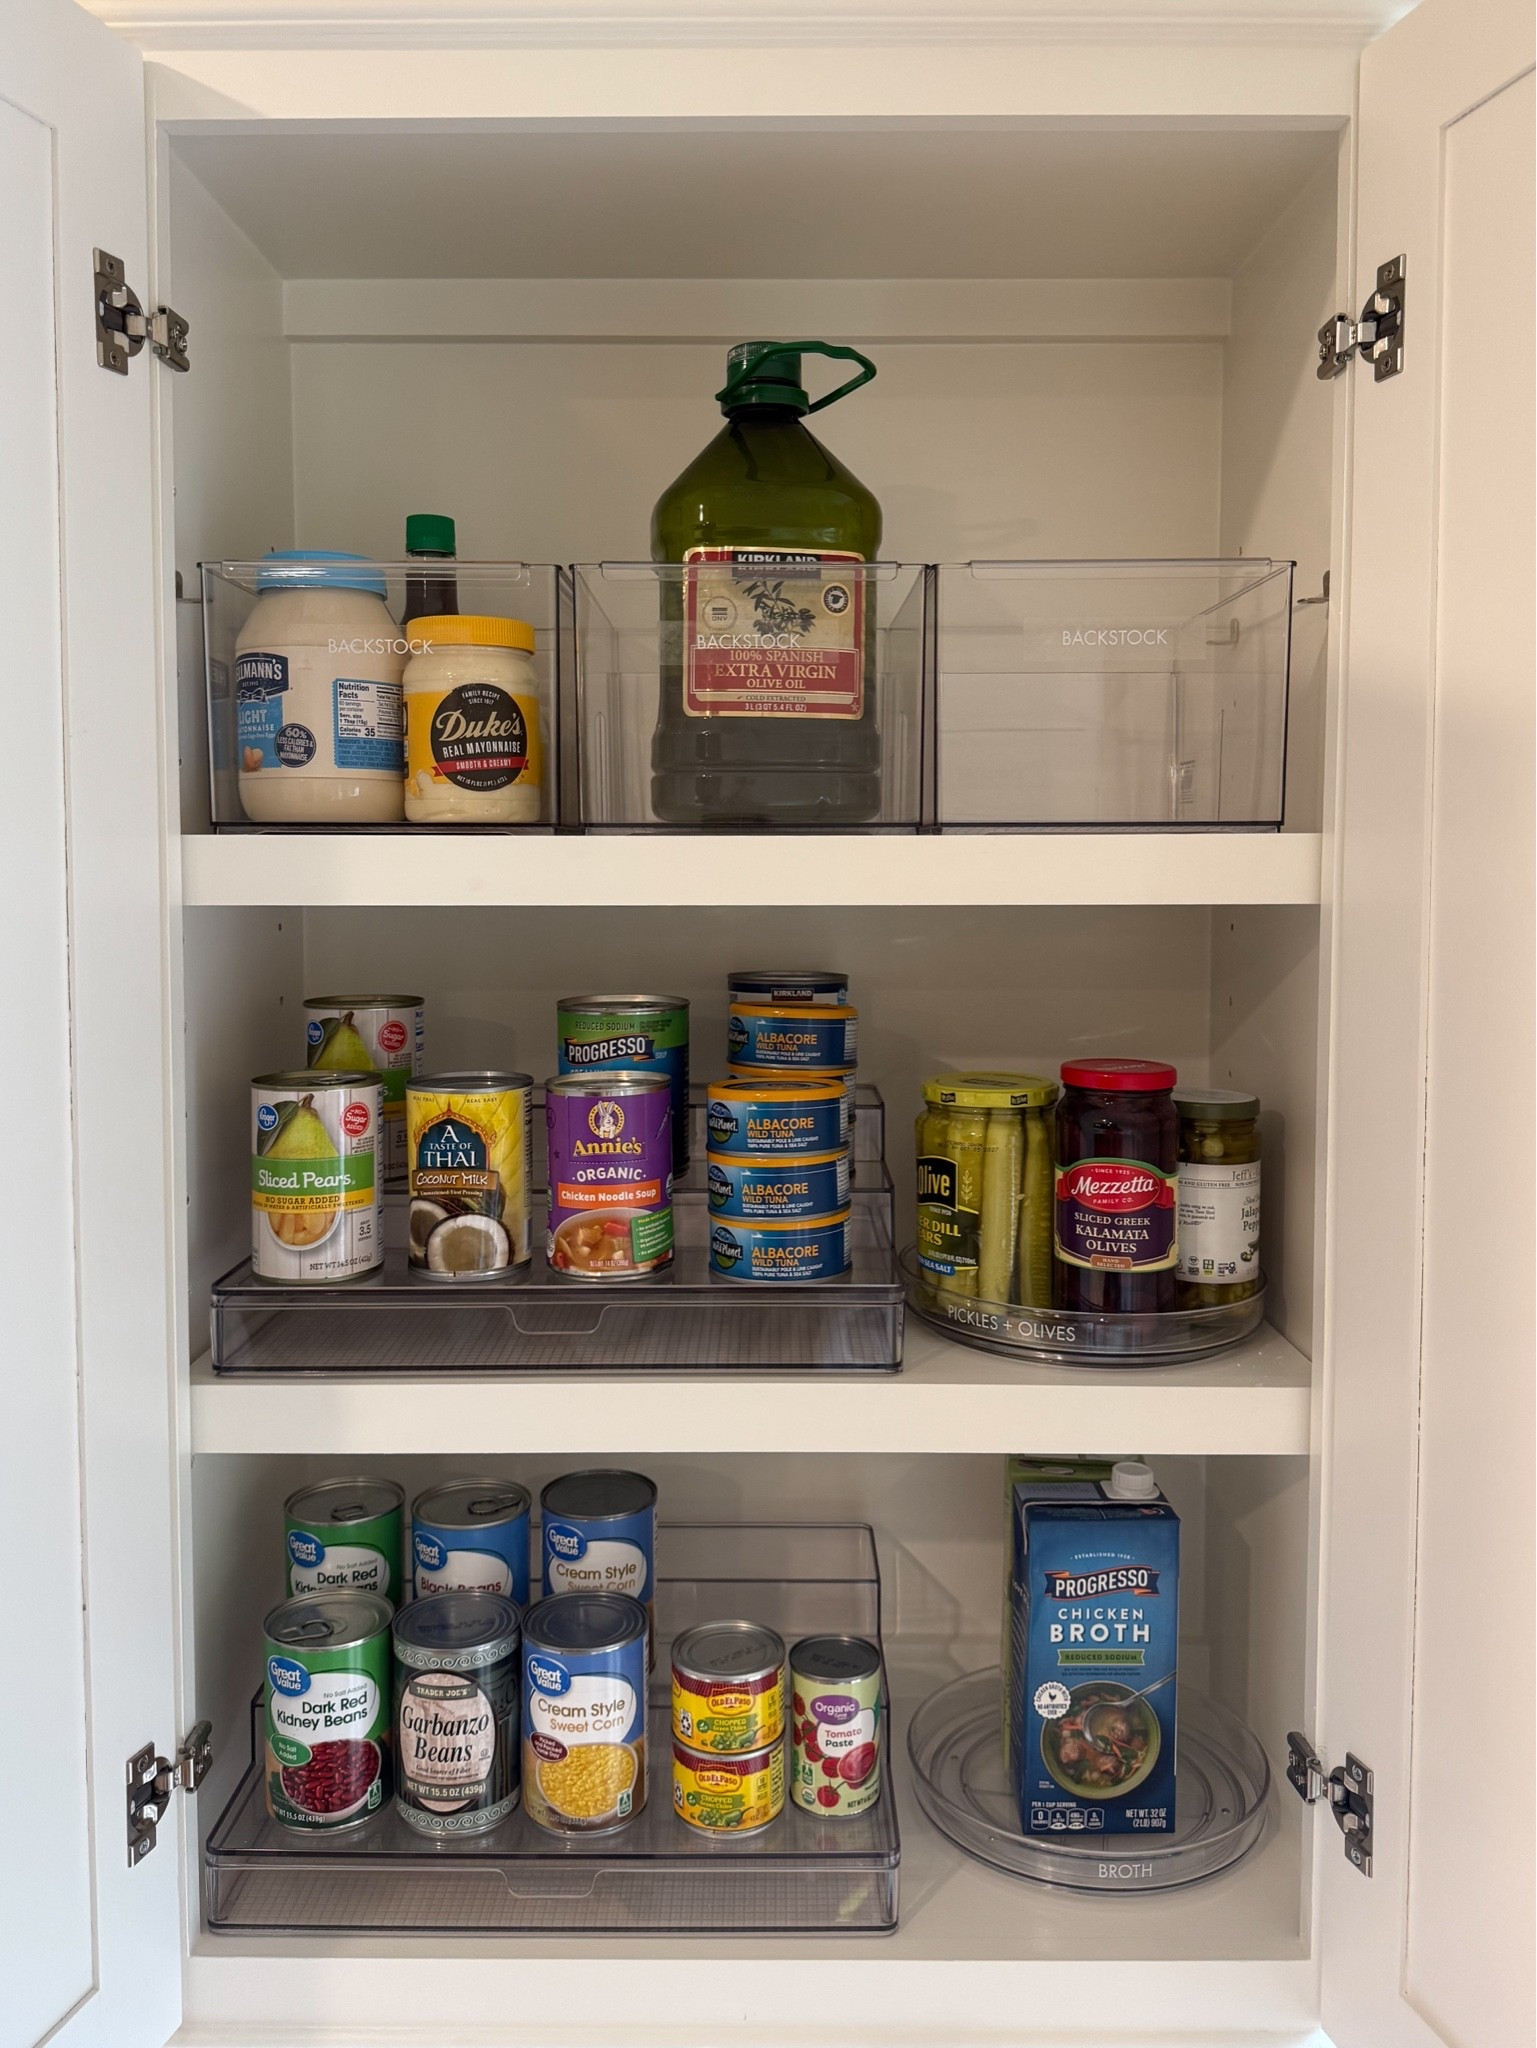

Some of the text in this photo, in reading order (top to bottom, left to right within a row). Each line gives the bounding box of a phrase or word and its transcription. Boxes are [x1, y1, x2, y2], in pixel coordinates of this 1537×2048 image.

[696, 634, 800, 649] BACKSTOCK
[1062, 629, 1168, 645] BACKSTOCK
[328, 638, 434, 655] BACKSTOCK
[730, 650, 824, 663] 100% SPANISH
[715, 663, 837, 680] EXTRA VIRGIN
[338, 683, 369, 691] Nutrition
[746, 679, 806, 689] OLIVE OIL
[339, 691, 358, 699] Facts
[364, 727, 375, 737] 35
[436, 709, 522, 741] Duke's
[285, 727, 307, 739] 60%
[442, 741, 520, 758] REAL MAYONNAISE
[455, 758, 512, 770] SMOOTH CREAMY
[575, 1021, 604, 1031] REDUCED
[605, 1022, 635, 1031] SODIUM
[756, 1032, 818, 1045] ALBACORE
[568, 1036, 646, 1063] PROGRESSO
[755, 1042, 775, 1050] WILD
[345, 1112, 367, 1125] Sugar
[746, 1117, 815, 1130] ALBACORE
[441, 1125, 460, 1143] A
[747, 1130, 795, 1138] WILD TUNA
[459, 1142, 472, 1150] OF
[573, 1136, 642, 1157] Annie's
[423, 1150, 477, 1167] THAI
[258, 1169, 352, 1190] Sliced Pears
[576, 1167, 642, 1183] ORGANIC
[741, 1182, 809, 1196] ALBACORE
[1070, 1176, 1154, 1197] Mezzetta
[265, 1195, 275, 1203] NO
[277, 1197, 306, 1205] SUGAR
[308, 1195, 340, 1205] ADDED
[561, 1188, 657, 1202] Chicken Noodle Soup
[742, 1195, 762, 1203] WILD
[1074, 1211, 1151, 1226] SLICED GREEK
[359, 1223, 372, 1236] 3.5
[932, 1220, 961, 1237] DILL
[1075, 1223, 1150, 1240] KALAMATA
[751, 1244, 819, 1259] ALBACORE
[1085, 1239, 1137, 1253] OLIVES
[310, 1262, 324, 1271] NET
[324, 1261, 337, 1269] WT
[751, 1258, 800, 1267] WILD TUNA
[934, 1262, 952, 1273] SALT
[947, 1304, 1076, 1342] PICKLES + OLIVES
[290, 1535, 316, 1554] Great
[549, 1529, 579, 1548] Great
[415, 1537, 440, 1558] Great
[555, 1542, 579, 1556] Value
[295, 1549, 316, 1561] Value
[419, 1551, 440, 1566] Value
[1074, 1552, 1116, 1560] ESTABLISHED
[317, 1566, 378, 1584] Dark Red
[556, 1563, 637, 1580] Cream Style
[1056, 1569, 1148, 1597] PROGRESSO
[1058, 1607, 1143, 1620] CHICKEN
[1050, 1623, 1150, 1643] BROTH
[1065, 1653, 1103, 1661] REDUCED
[270, 1661, 301, 1683] Great
[531, 1660, 562, 1683] Great
[276, 1676, 301, 1690] Value
[347, 1683, 368, 1695] Added
[536, 1677, 562, 1691] Value
[417, 1686, 468, 1697] TRADER JOE'S
[302, 1692, 367, 1714] Dark Red
[537, 1698, 626, 1718] Cream Style
[815, 1700, 856, 1717] Organic
[277, 1706, 368, 1731] Kidney Beans
[402, 1705, 489, 1737] Garbanzo
[550, 1715, 624, 1733] Sweet Corn
[714, 1718, 747, 1726] CHOPPED
[825, 1727, 862, 1738] Tomato
[414, 1736, 473, 1763] Beans
[825, 1738, 854, 1748] Paste
[407, 1781, 486, 1796] NET WT 15.5 OZ (439g)
[700, 1794, 733, 1803] CHOPPED
[1125, 1809, 1138, 1818] NET
[1150, 1808, 1158, 1817] 32
[1158, 1808, 1167, 1817] OZ
[1098, 1863, 1153, 1879] BROTH
